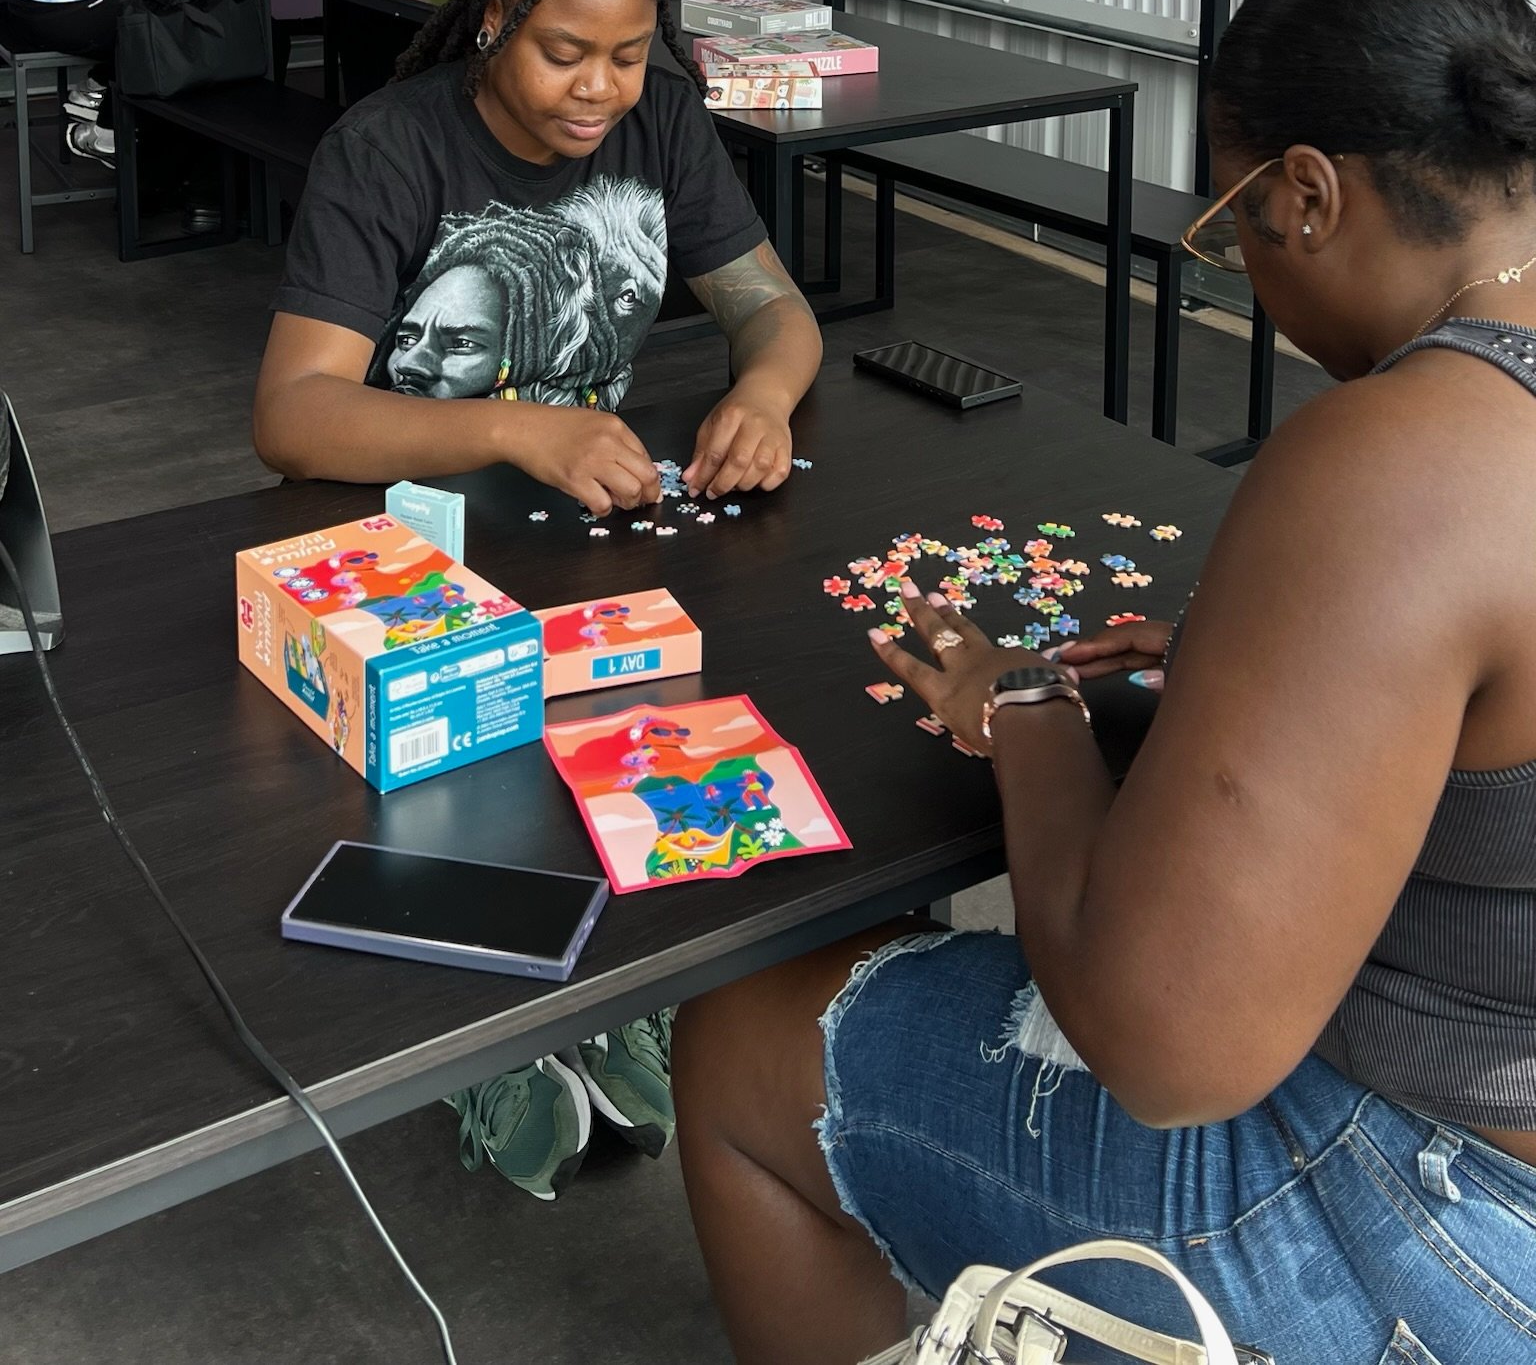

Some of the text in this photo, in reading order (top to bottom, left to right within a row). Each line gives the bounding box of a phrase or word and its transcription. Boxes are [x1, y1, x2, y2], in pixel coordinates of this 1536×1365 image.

[808, 55, 843, 71] UZZLE
[276, 538, 337, 564] mind
[408, 641, 441, 655] Take
[443, 638, 452, 647] a
[608, 653, 646, 675] DAY 1
